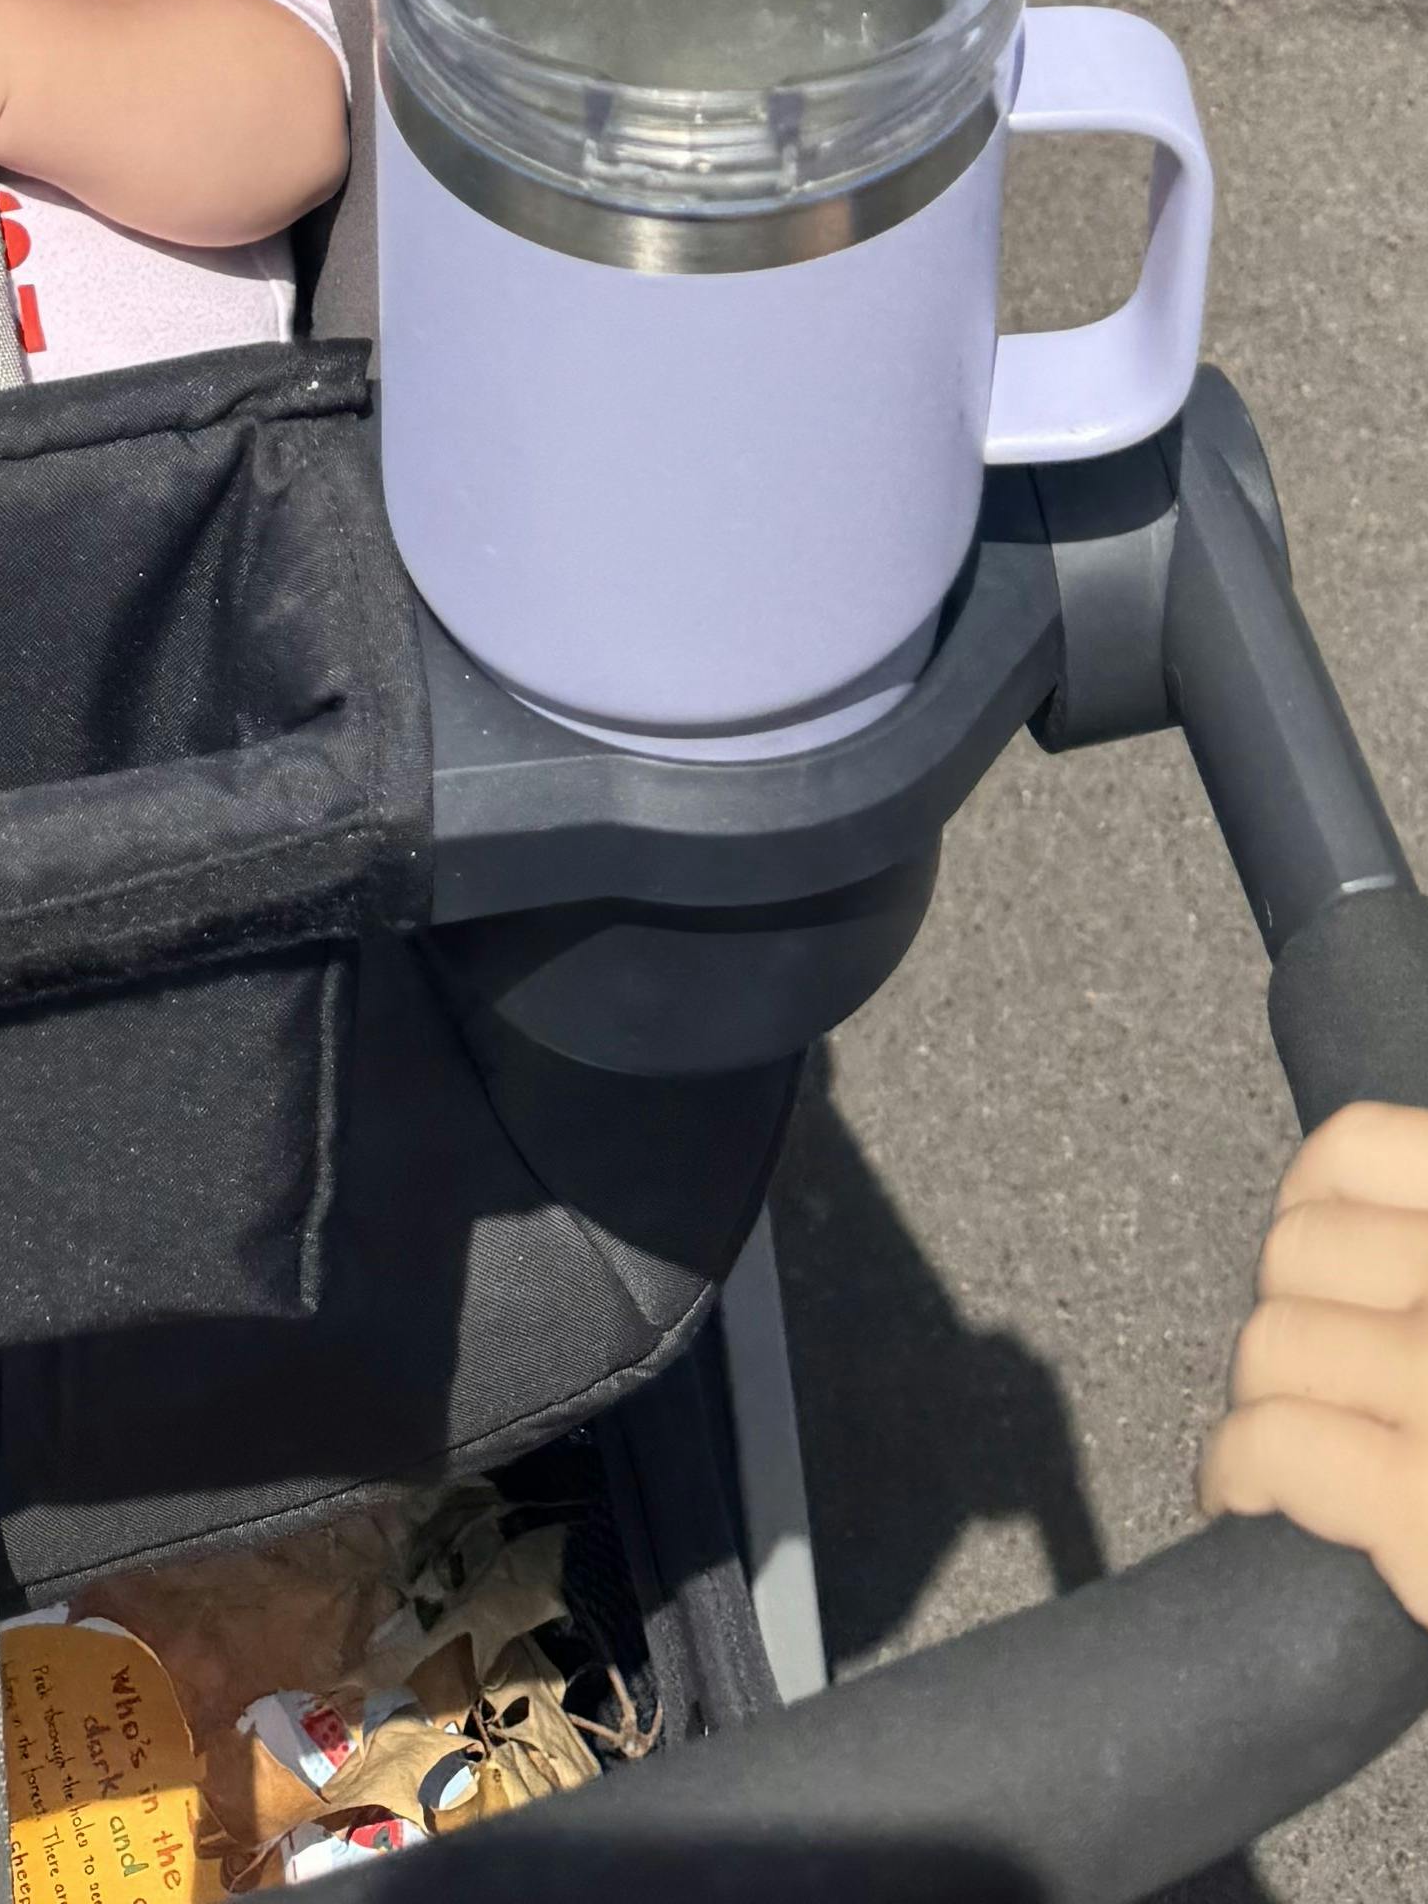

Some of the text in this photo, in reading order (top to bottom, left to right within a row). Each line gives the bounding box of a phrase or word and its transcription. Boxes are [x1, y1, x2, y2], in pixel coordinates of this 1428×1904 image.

[18, 1734, 35, 1761] the
[42, 1824, 66, 1878] There
[62, 1773, 81, 1802] the
[84, 1714, 124, 1800] dark
[109, 1815, 150, 1878] and
[111, 1664, 185, 1891] Who's in the
